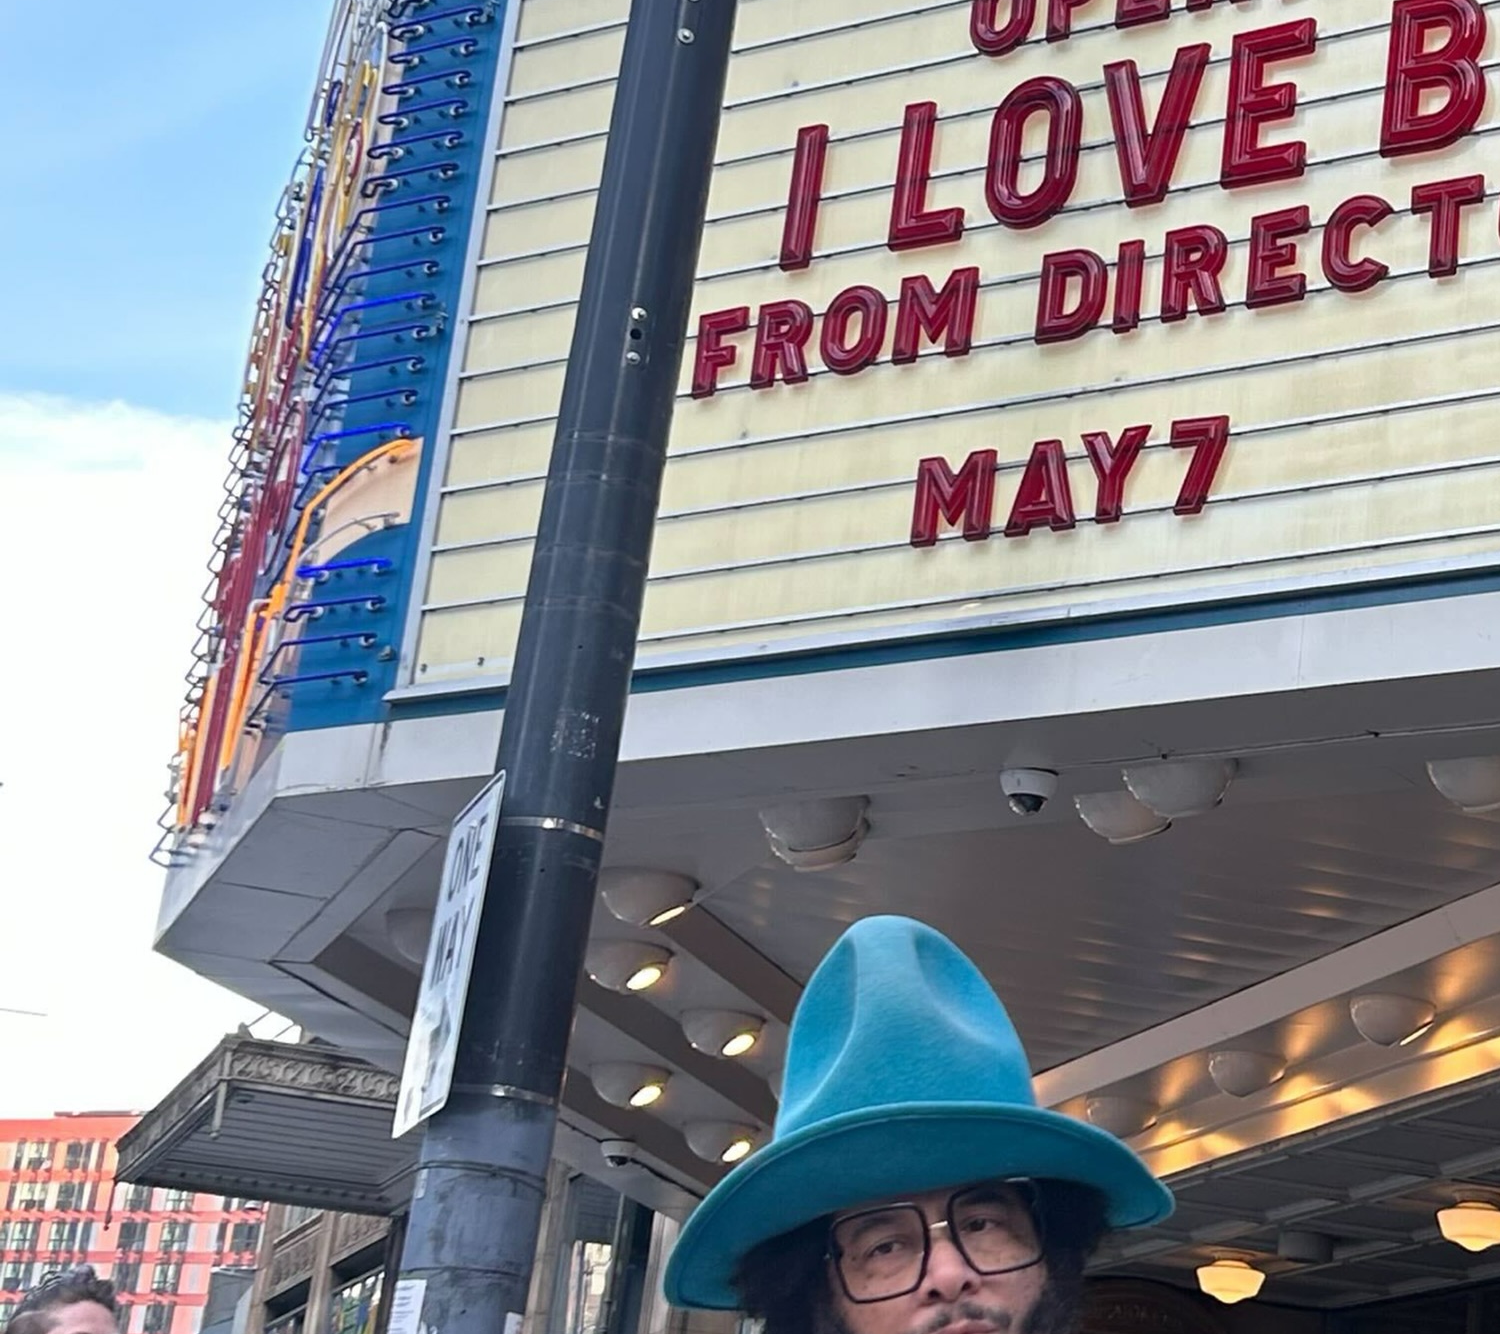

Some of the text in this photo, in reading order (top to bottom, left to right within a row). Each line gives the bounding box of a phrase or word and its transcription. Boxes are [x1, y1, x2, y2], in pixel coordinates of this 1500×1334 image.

[779, 123, 830, 272] I
[885, 16, 1318, 252] LOVE
[691, 265, 981, 400] FROM
[447, 813, 489, 902] ONE
[429, 896, 475, 991] WAY
